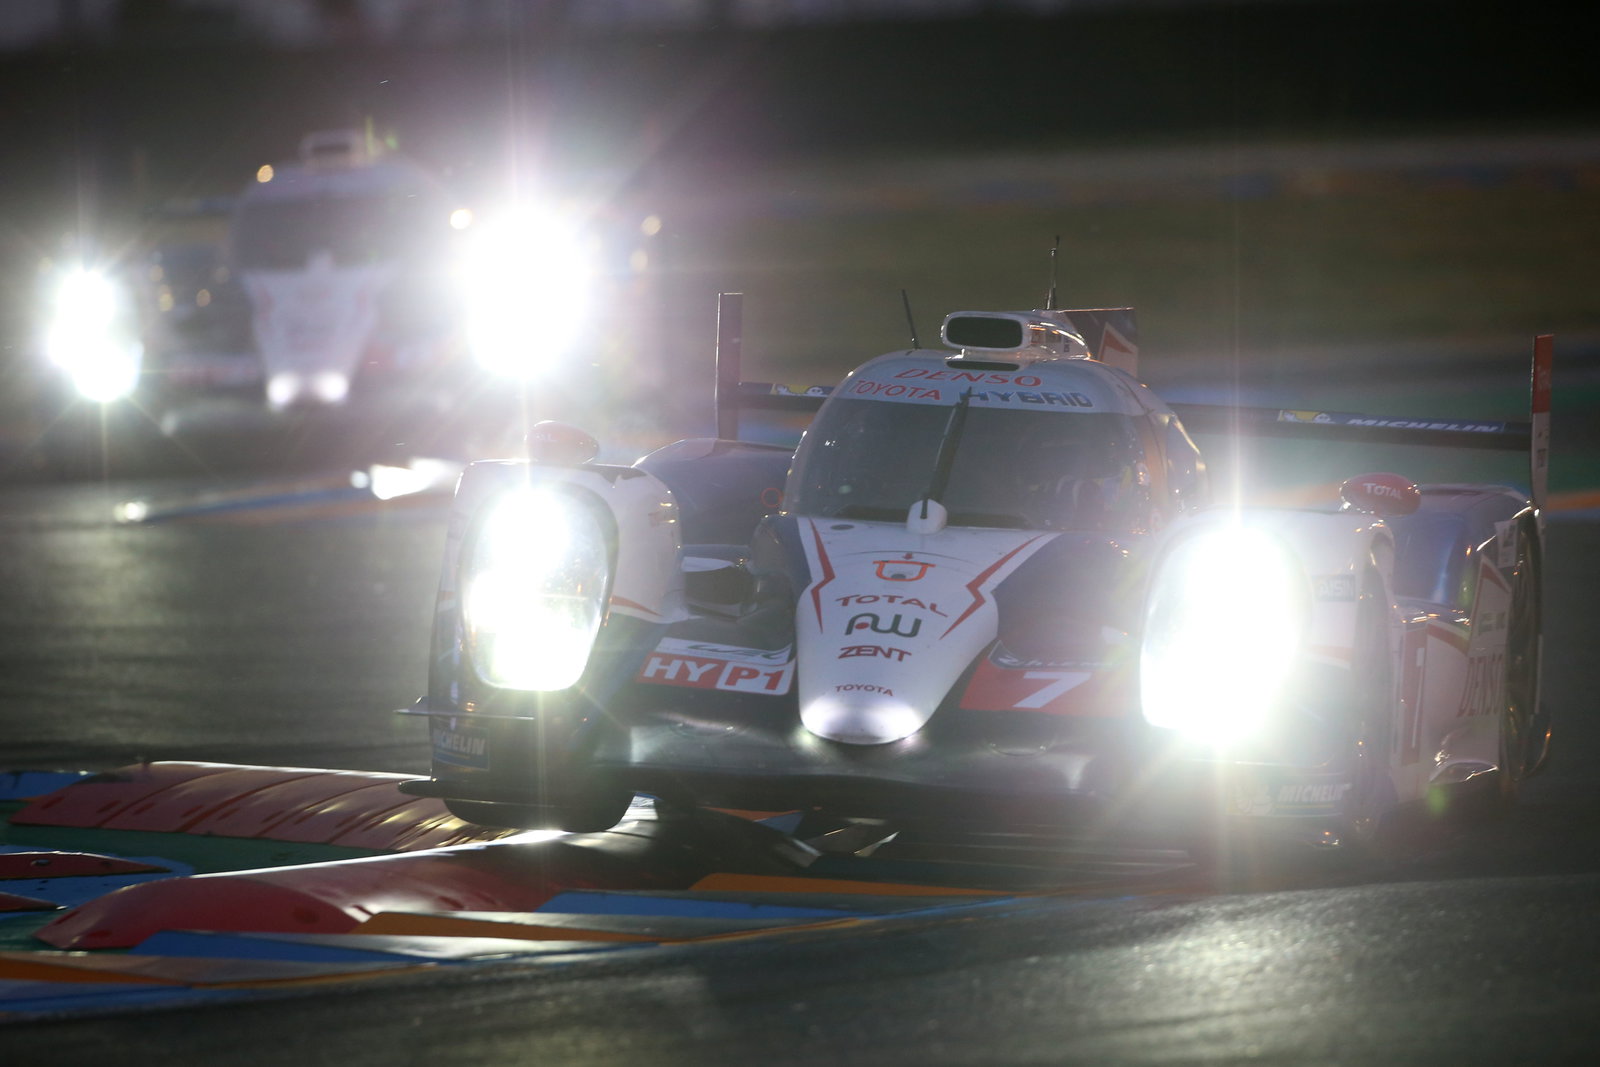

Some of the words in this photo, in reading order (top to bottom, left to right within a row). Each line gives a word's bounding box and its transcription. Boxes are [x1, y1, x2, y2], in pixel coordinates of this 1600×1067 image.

[895, 368, 1042, 388] DENSO
[850, 379, 943, 401] TOYOTA
[958, 390, 1094, 408] HYBRID
[1348, 418, 1499, 433] MICHELIN
[1362, 482, 1403, 501] TOTAL
[835, 594, 950, 618] TOTAL
[837, 645, 913, 662] ZENT
[834, 684, 894, 697] TOYOTA
[1011, 671, 1093, 709] 7
